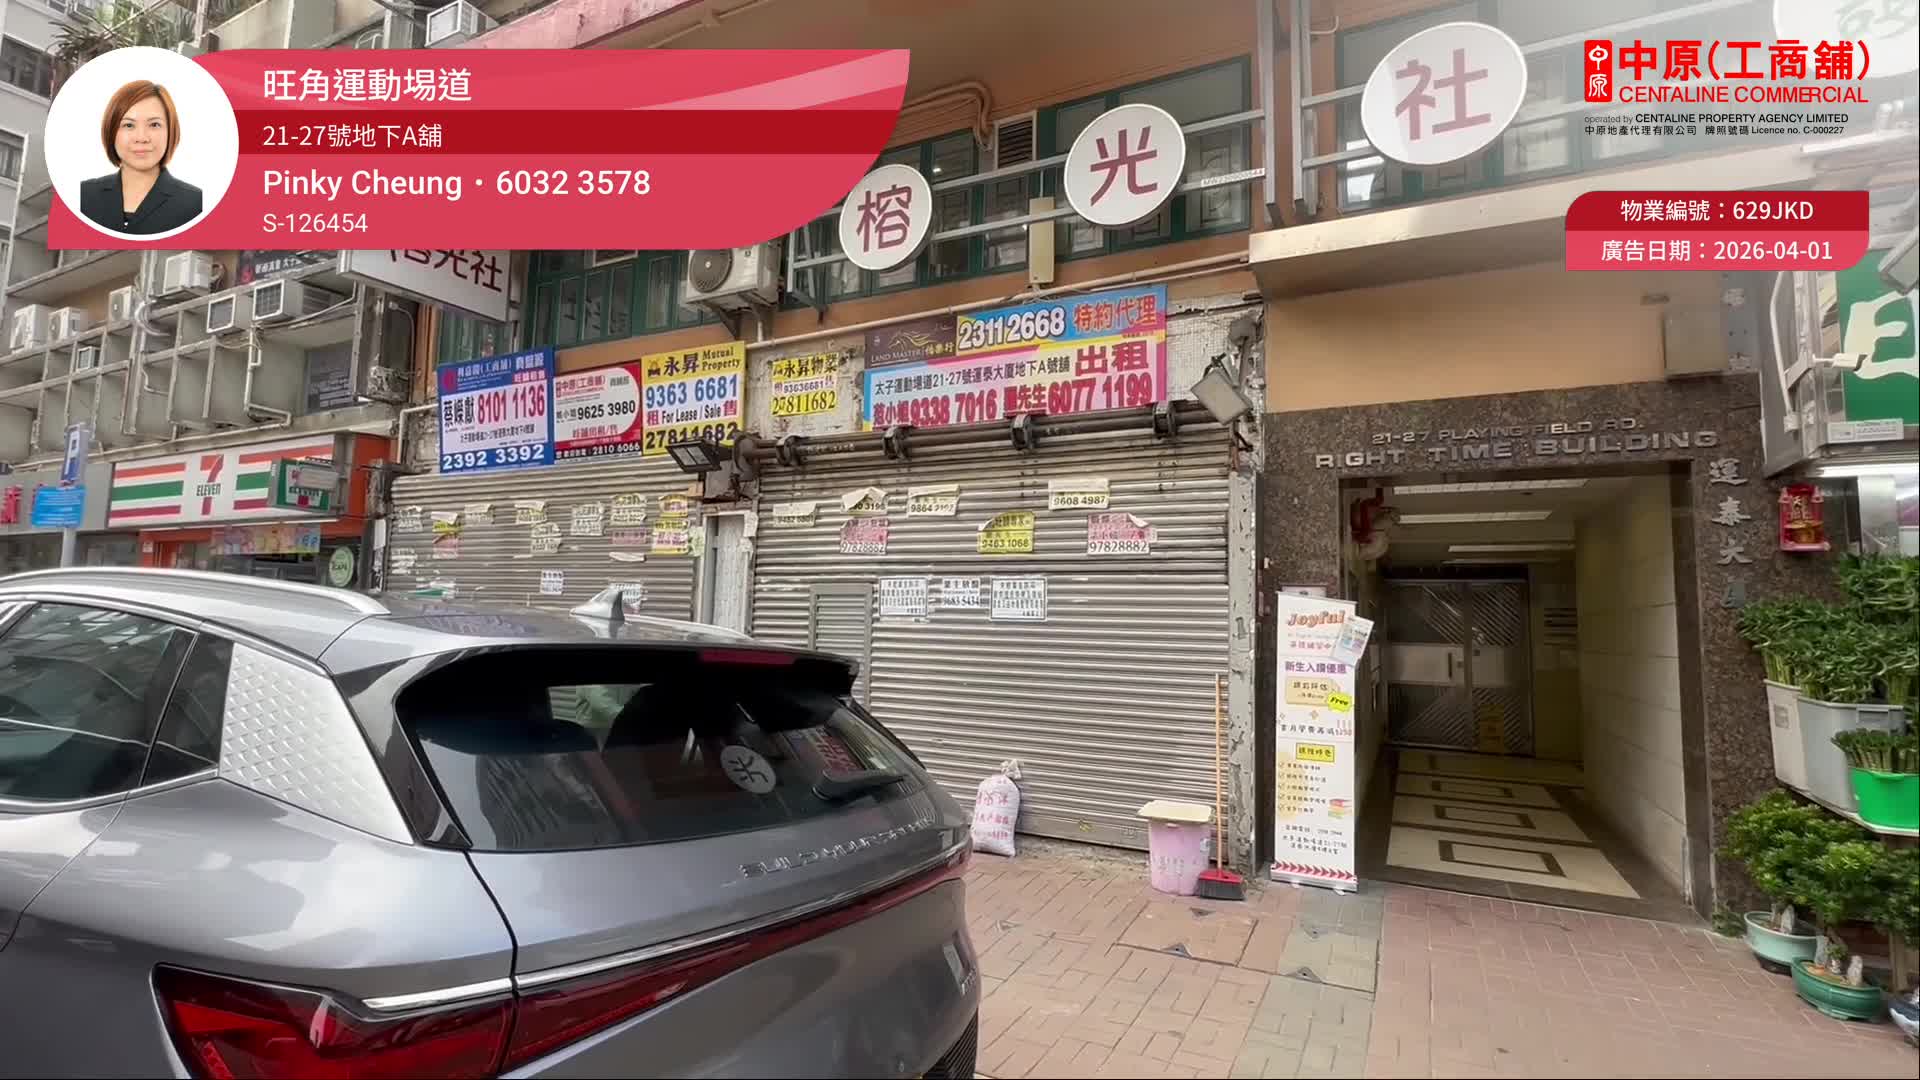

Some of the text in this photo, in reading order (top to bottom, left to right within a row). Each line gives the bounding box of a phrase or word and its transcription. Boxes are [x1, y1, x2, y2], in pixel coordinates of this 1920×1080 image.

[856, 48, 1491, 252] 榕 光 社
[1074, 294, 1158, 332] 特約代理
[959, 306, 1066, 350] 2311 2668
[664, 352, 699, 377] 永昇
[702, 358, 741, 372] Property
[703, 346, 735, 360] Mutual
[1075, 340, 1150, 377] 出租
[478, 389, 507, 425] 8101
[512, 383, 546, 420] 1136
[645, 373, 738, 409] 9363 6681
[910, 395, 951, 427] 9338
[954, 388, 999, 423] 7016
[1047, 377, 1097, 416] 6077
[1102, 372, 1153, 410] 1199
[577, 404, 604, 420] 9625
[607, 399, 636, 416] 3980
[647, 409, 659, 426] 租
[662, 410, 674, 424] For
[676, 407, 698, 423] Lease
[704, 403, 721, 419] Sale
[723, 399, 738, 416] 售
[1371, 430, 1430, 445] 21-27
[1438, 426, 1523, 441] PLAYING
[1533, 420, 1592, 434] FIELD
[442, 450, 488, 470] 2392
[495, 443, 545, 463] 3392
[1314, 430, 1719, 469] RIGHT TIME BUILDING
[1089, 540, 1148, 553] 97828882
[1287, 609, 1346, 628] Joyful
